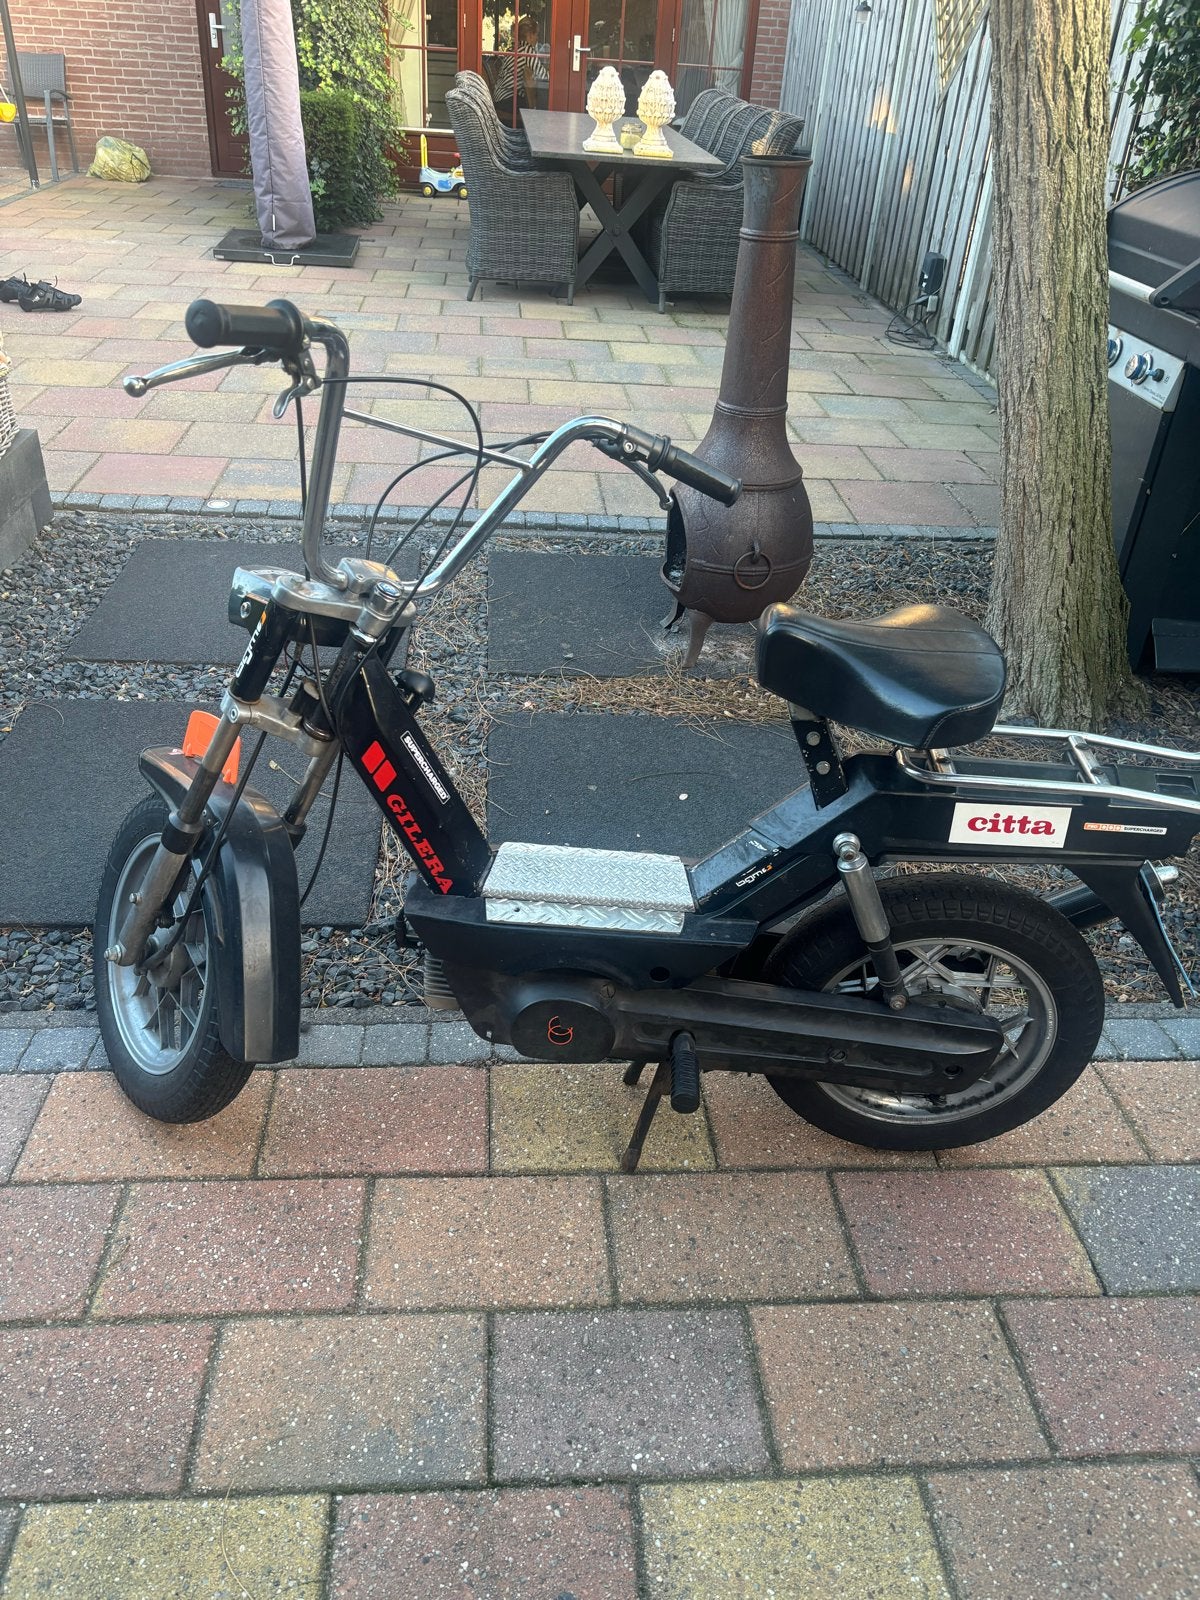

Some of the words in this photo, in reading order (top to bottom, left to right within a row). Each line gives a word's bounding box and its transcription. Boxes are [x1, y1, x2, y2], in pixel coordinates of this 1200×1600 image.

[403, 736, 449, 801] SUPERCHARGED
[386, 794, 454, 894] GILERA
[967, 813, 1056, 835] citta
